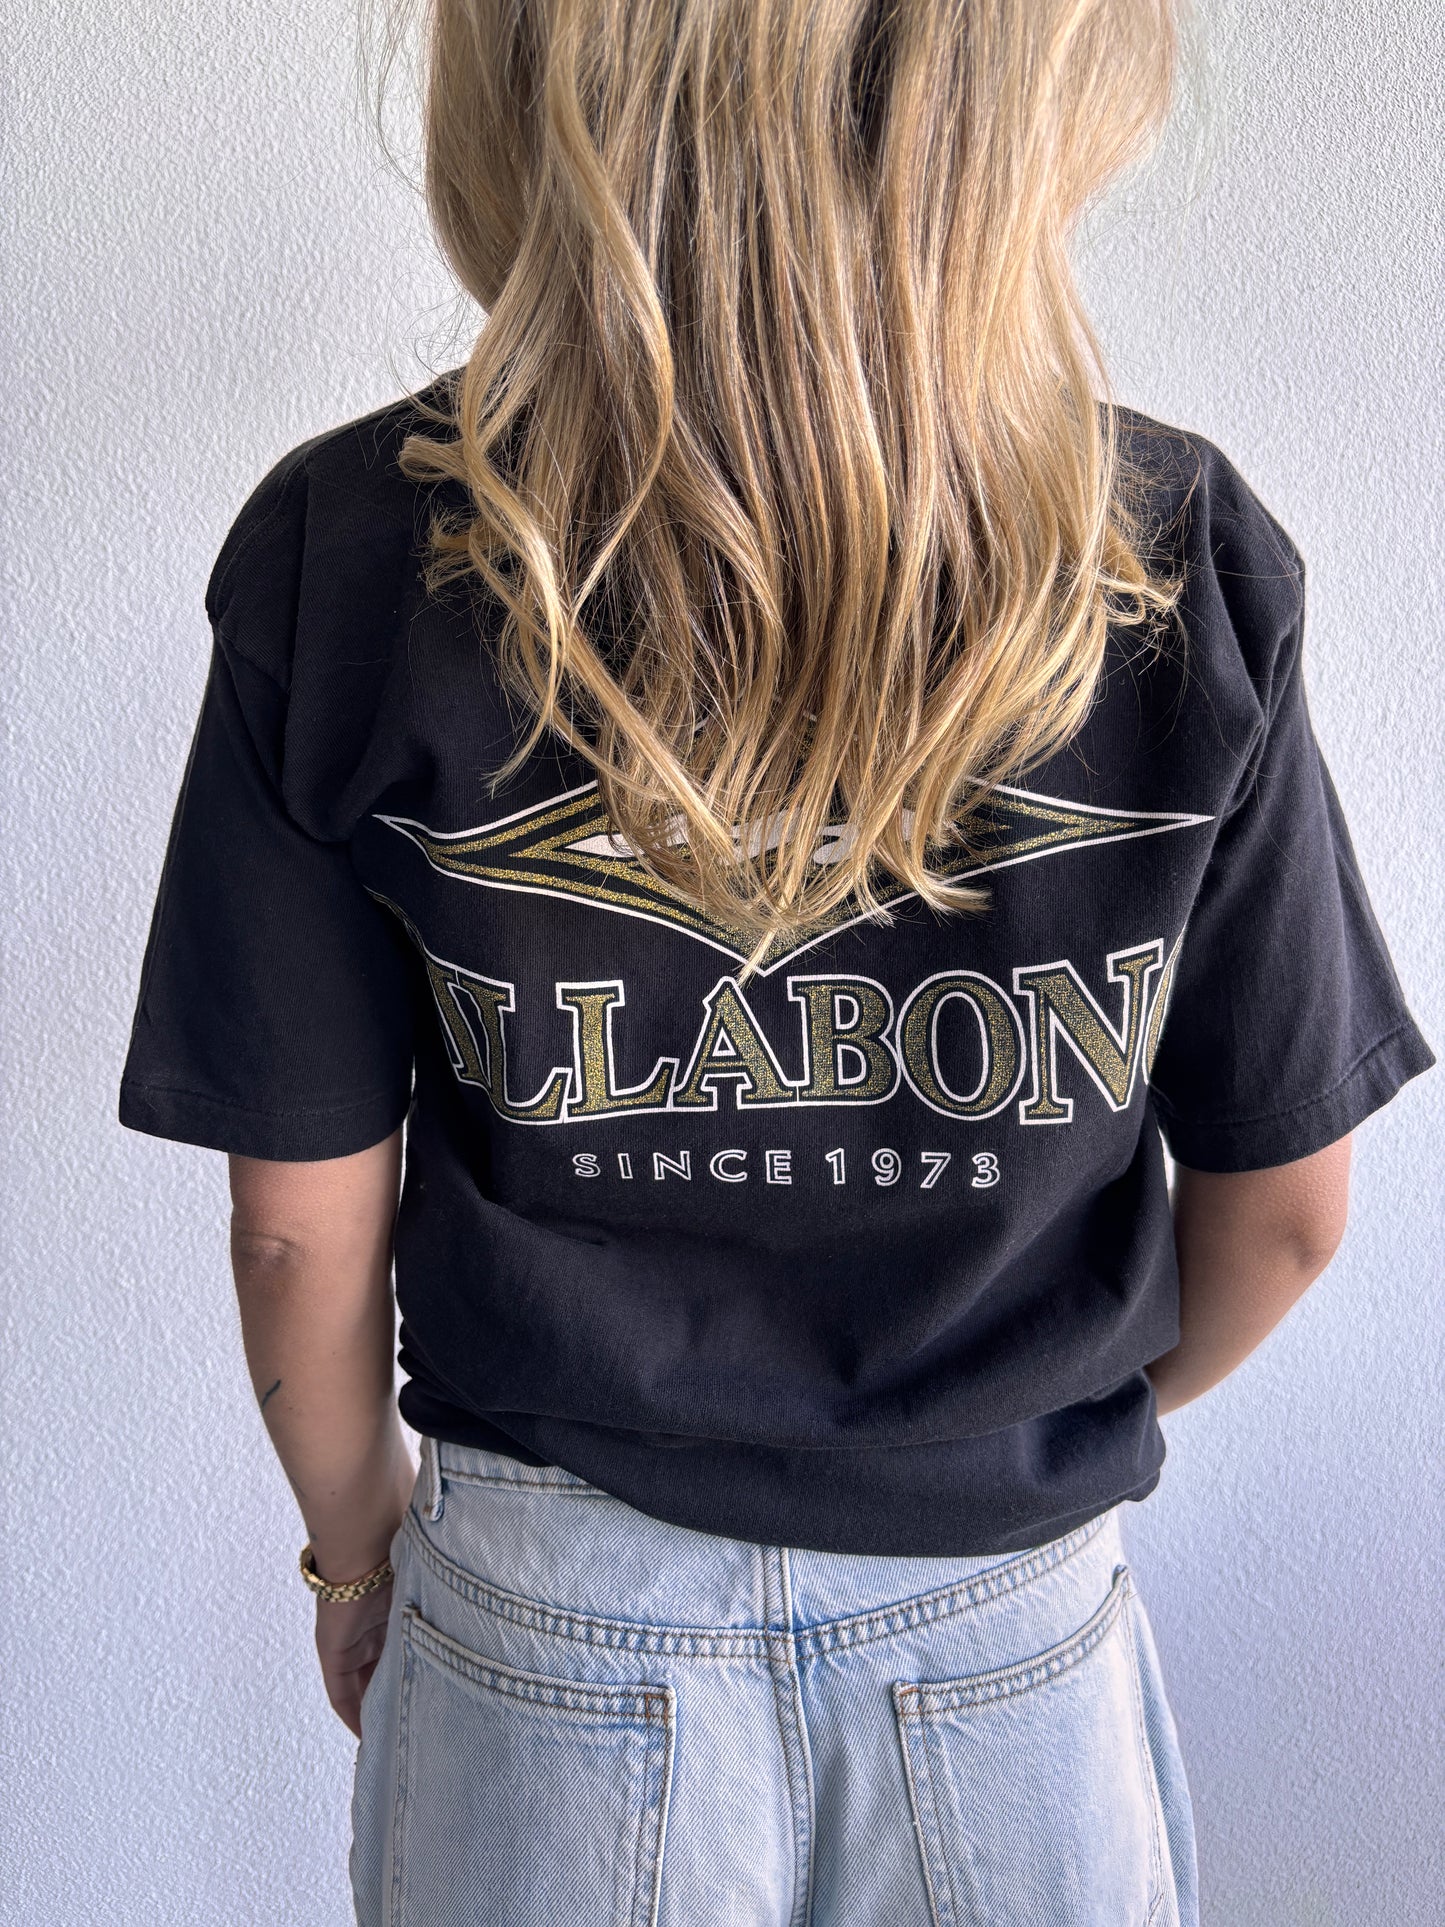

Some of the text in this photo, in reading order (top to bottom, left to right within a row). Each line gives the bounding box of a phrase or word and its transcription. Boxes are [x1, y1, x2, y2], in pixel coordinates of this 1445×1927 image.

[363, 885, 1187, 1125] ILLABON
[572, 1147, 1001, 1189] SINCE 1973
